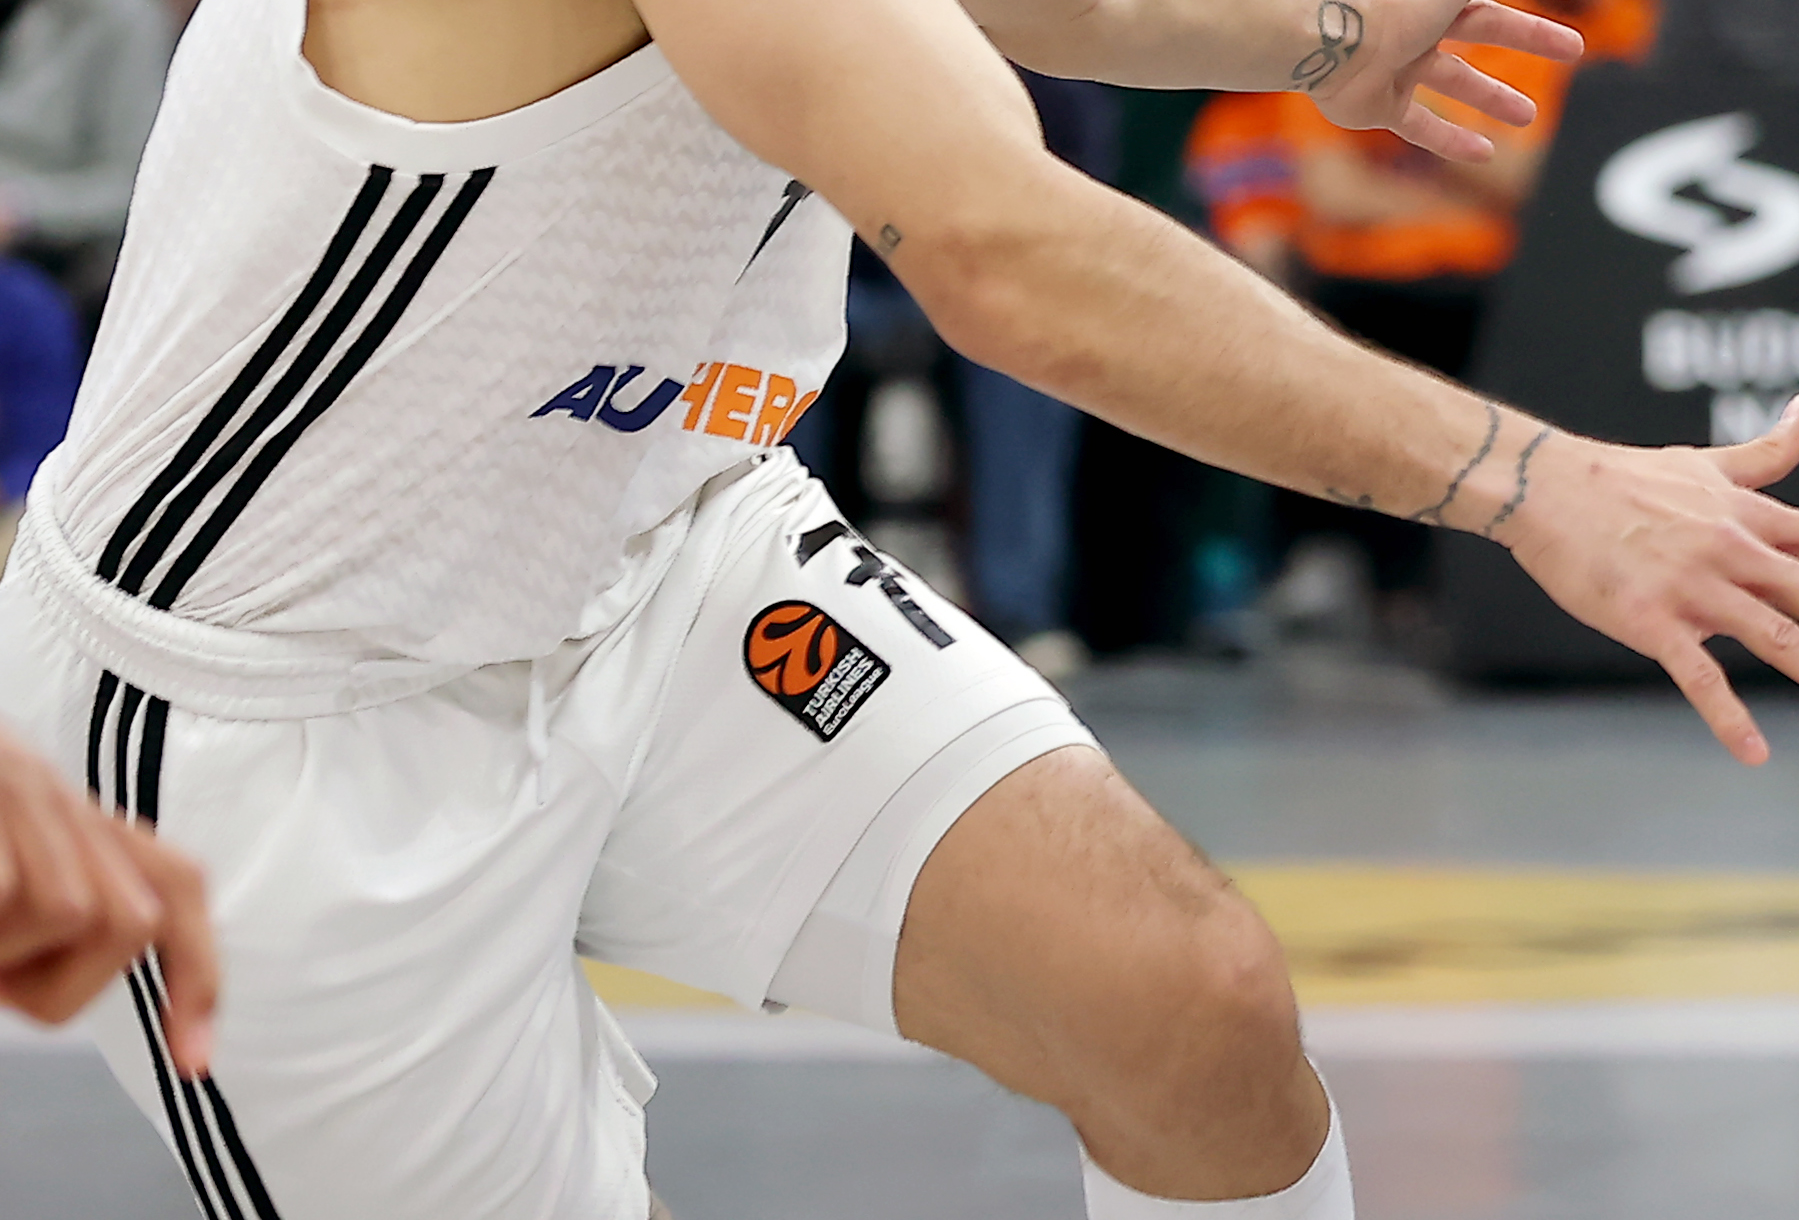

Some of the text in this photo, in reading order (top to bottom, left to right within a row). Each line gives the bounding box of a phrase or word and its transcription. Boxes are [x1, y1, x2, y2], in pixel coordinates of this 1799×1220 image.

[802, 646, 865, 717] TURKISH
[815, 656, 875, 729] AIRLINES
[823, 666, 884, 736] EuroLeague
